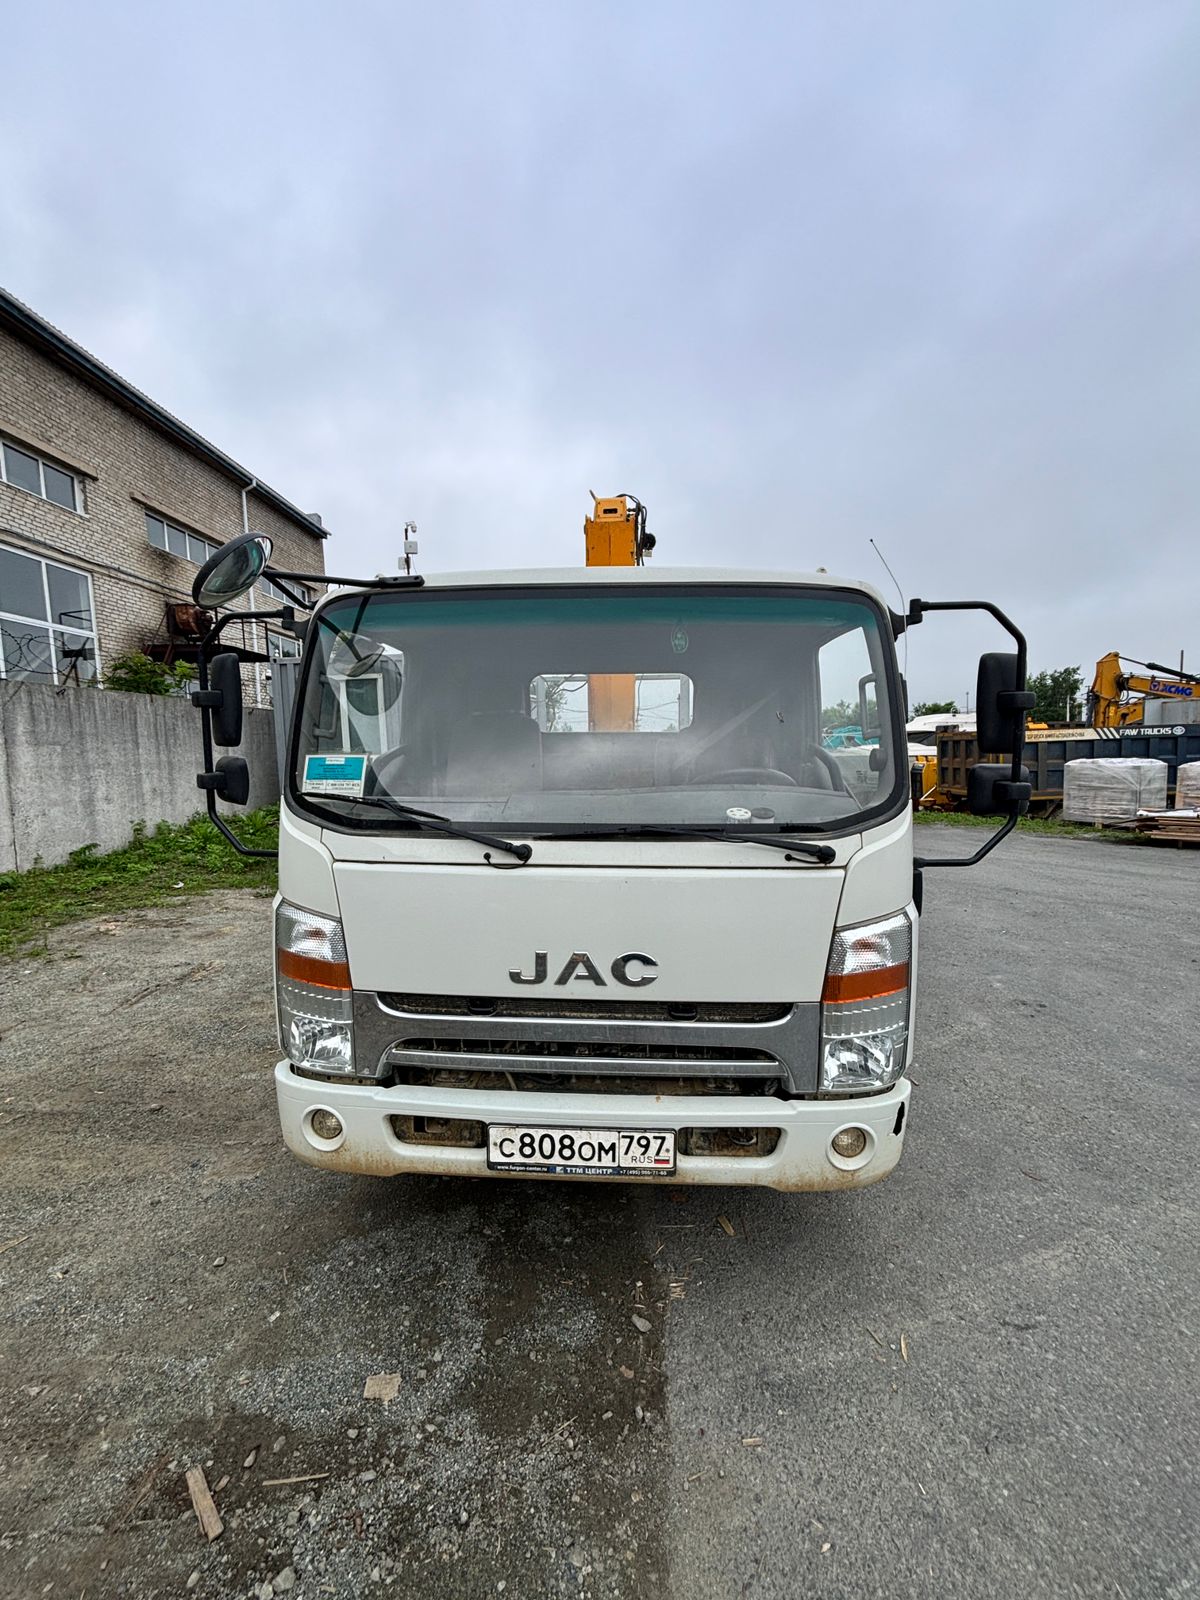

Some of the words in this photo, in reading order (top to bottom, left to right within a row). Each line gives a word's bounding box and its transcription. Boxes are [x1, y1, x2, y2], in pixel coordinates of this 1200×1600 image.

[1161, 683, 1193, 696] XCMG
[1119, 728, 1139, 736] FAW
[1140, 727, 1172, 736] TRUCKS
[509, 951, 659, 987] JAC
[621, 1135, 666, 1156] 797
[631, 1155, 653, 1164] RUS
[585, 1167, 613, 1176] ЦЕНТР
